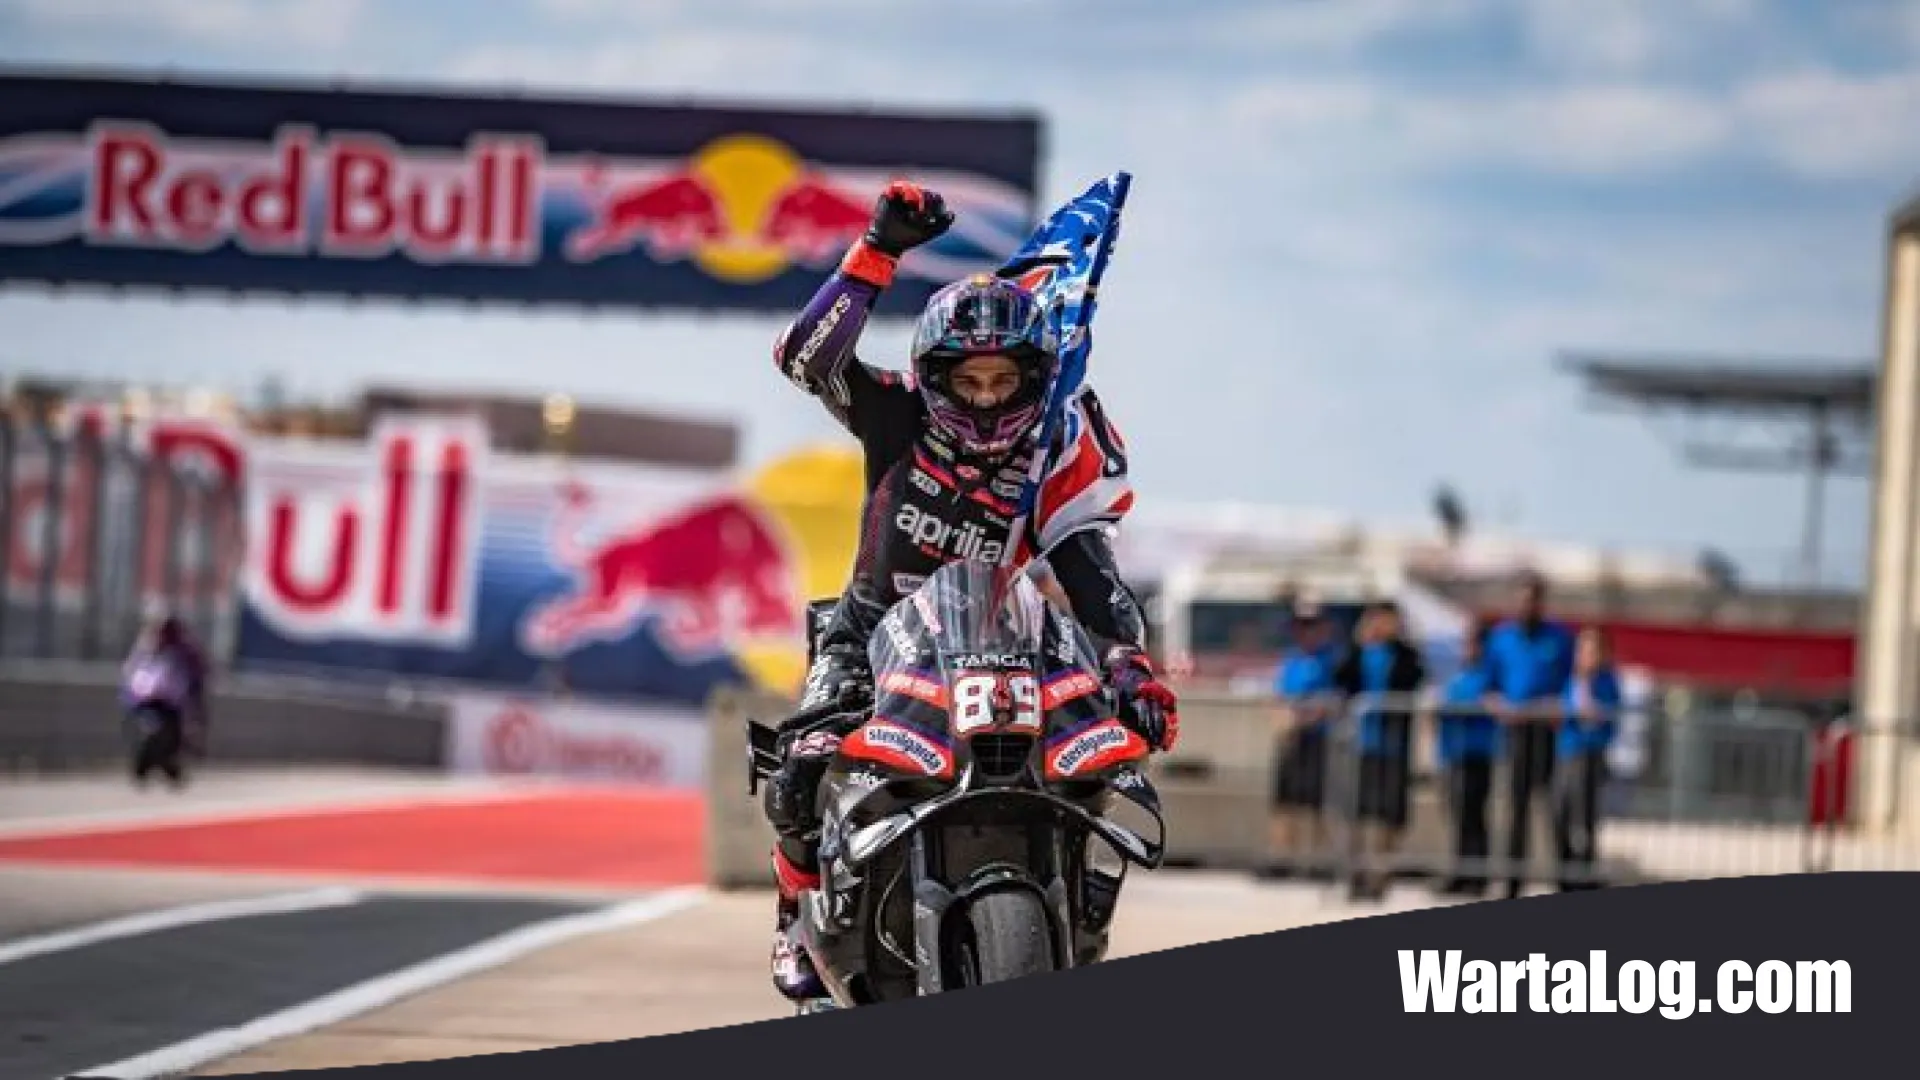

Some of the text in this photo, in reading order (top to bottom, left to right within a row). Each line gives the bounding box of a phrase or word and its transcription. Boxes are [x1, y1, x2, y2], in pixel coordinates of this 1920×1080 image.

[94, 129, 534, 257] Red Bull
[896, 503, 1002, 564] aprilia
[953, 676, 1041, 729] 89
[868, 728, 942, 771] sterilgarda
[1057, 727, 1125, 772] sterilgarda
